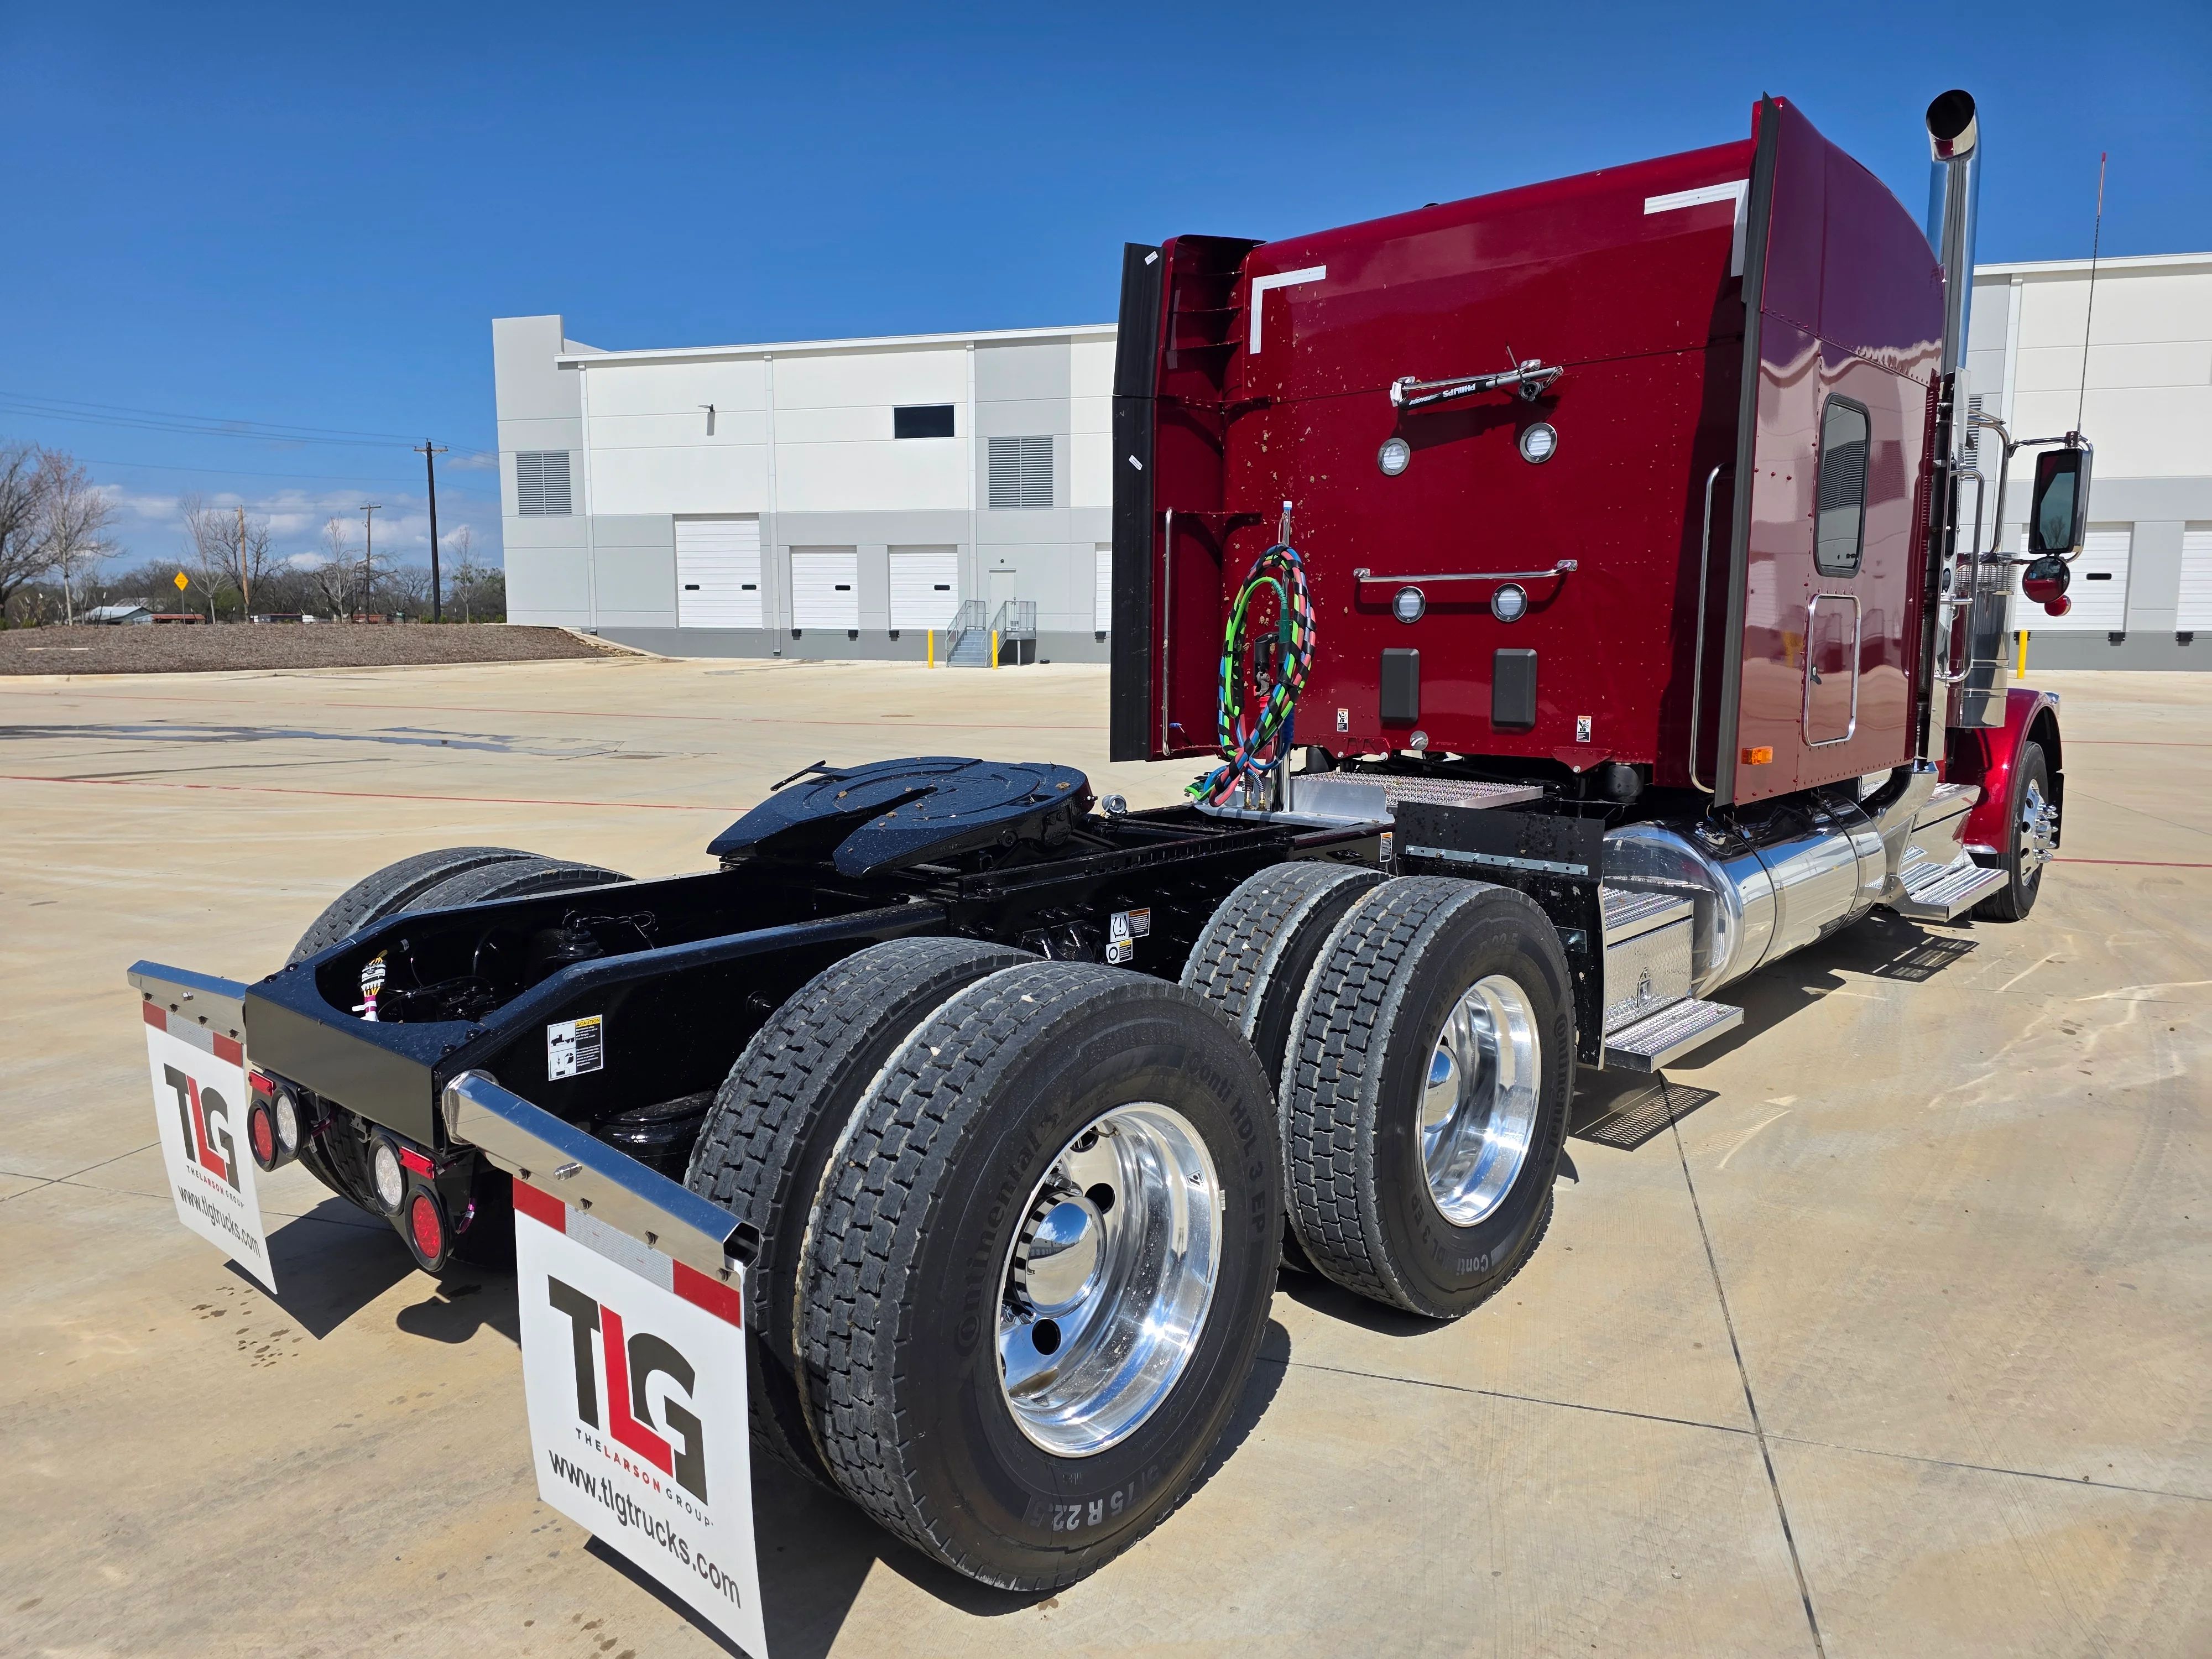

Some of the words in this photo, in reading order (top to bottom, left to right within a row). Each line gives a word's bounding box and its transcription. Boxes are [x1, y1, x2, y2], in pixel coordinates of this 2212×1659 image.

[1187, 1051, 1234, 1104] Conti
[1547, 1013, 1569, 1149] Continental
[164, 1063, 241, 1194] TLG
[1229, 1097, 1258, 1158] HDL
[1249, 1161, 1264, 1183] 3
[178, 1185, 261, 1258] www.tlgtrucks.com
[225, 1190, 243, 1209] GROUP
[1251, 1190, 1266, 1234] EP
[954, 1129, 1042, 1357] Continental
[1455, 1254, 1489, 1276] Conti
[547, 1274, 708, 1506] TLG
[548, 1449, 741, 1609] www.tlgtrucks.com
[665, 1488, 710, 1527] GROUP
[1029, 1498, 1082, 1531] 22.5
[1087, 1498, 1103, 1527] R
